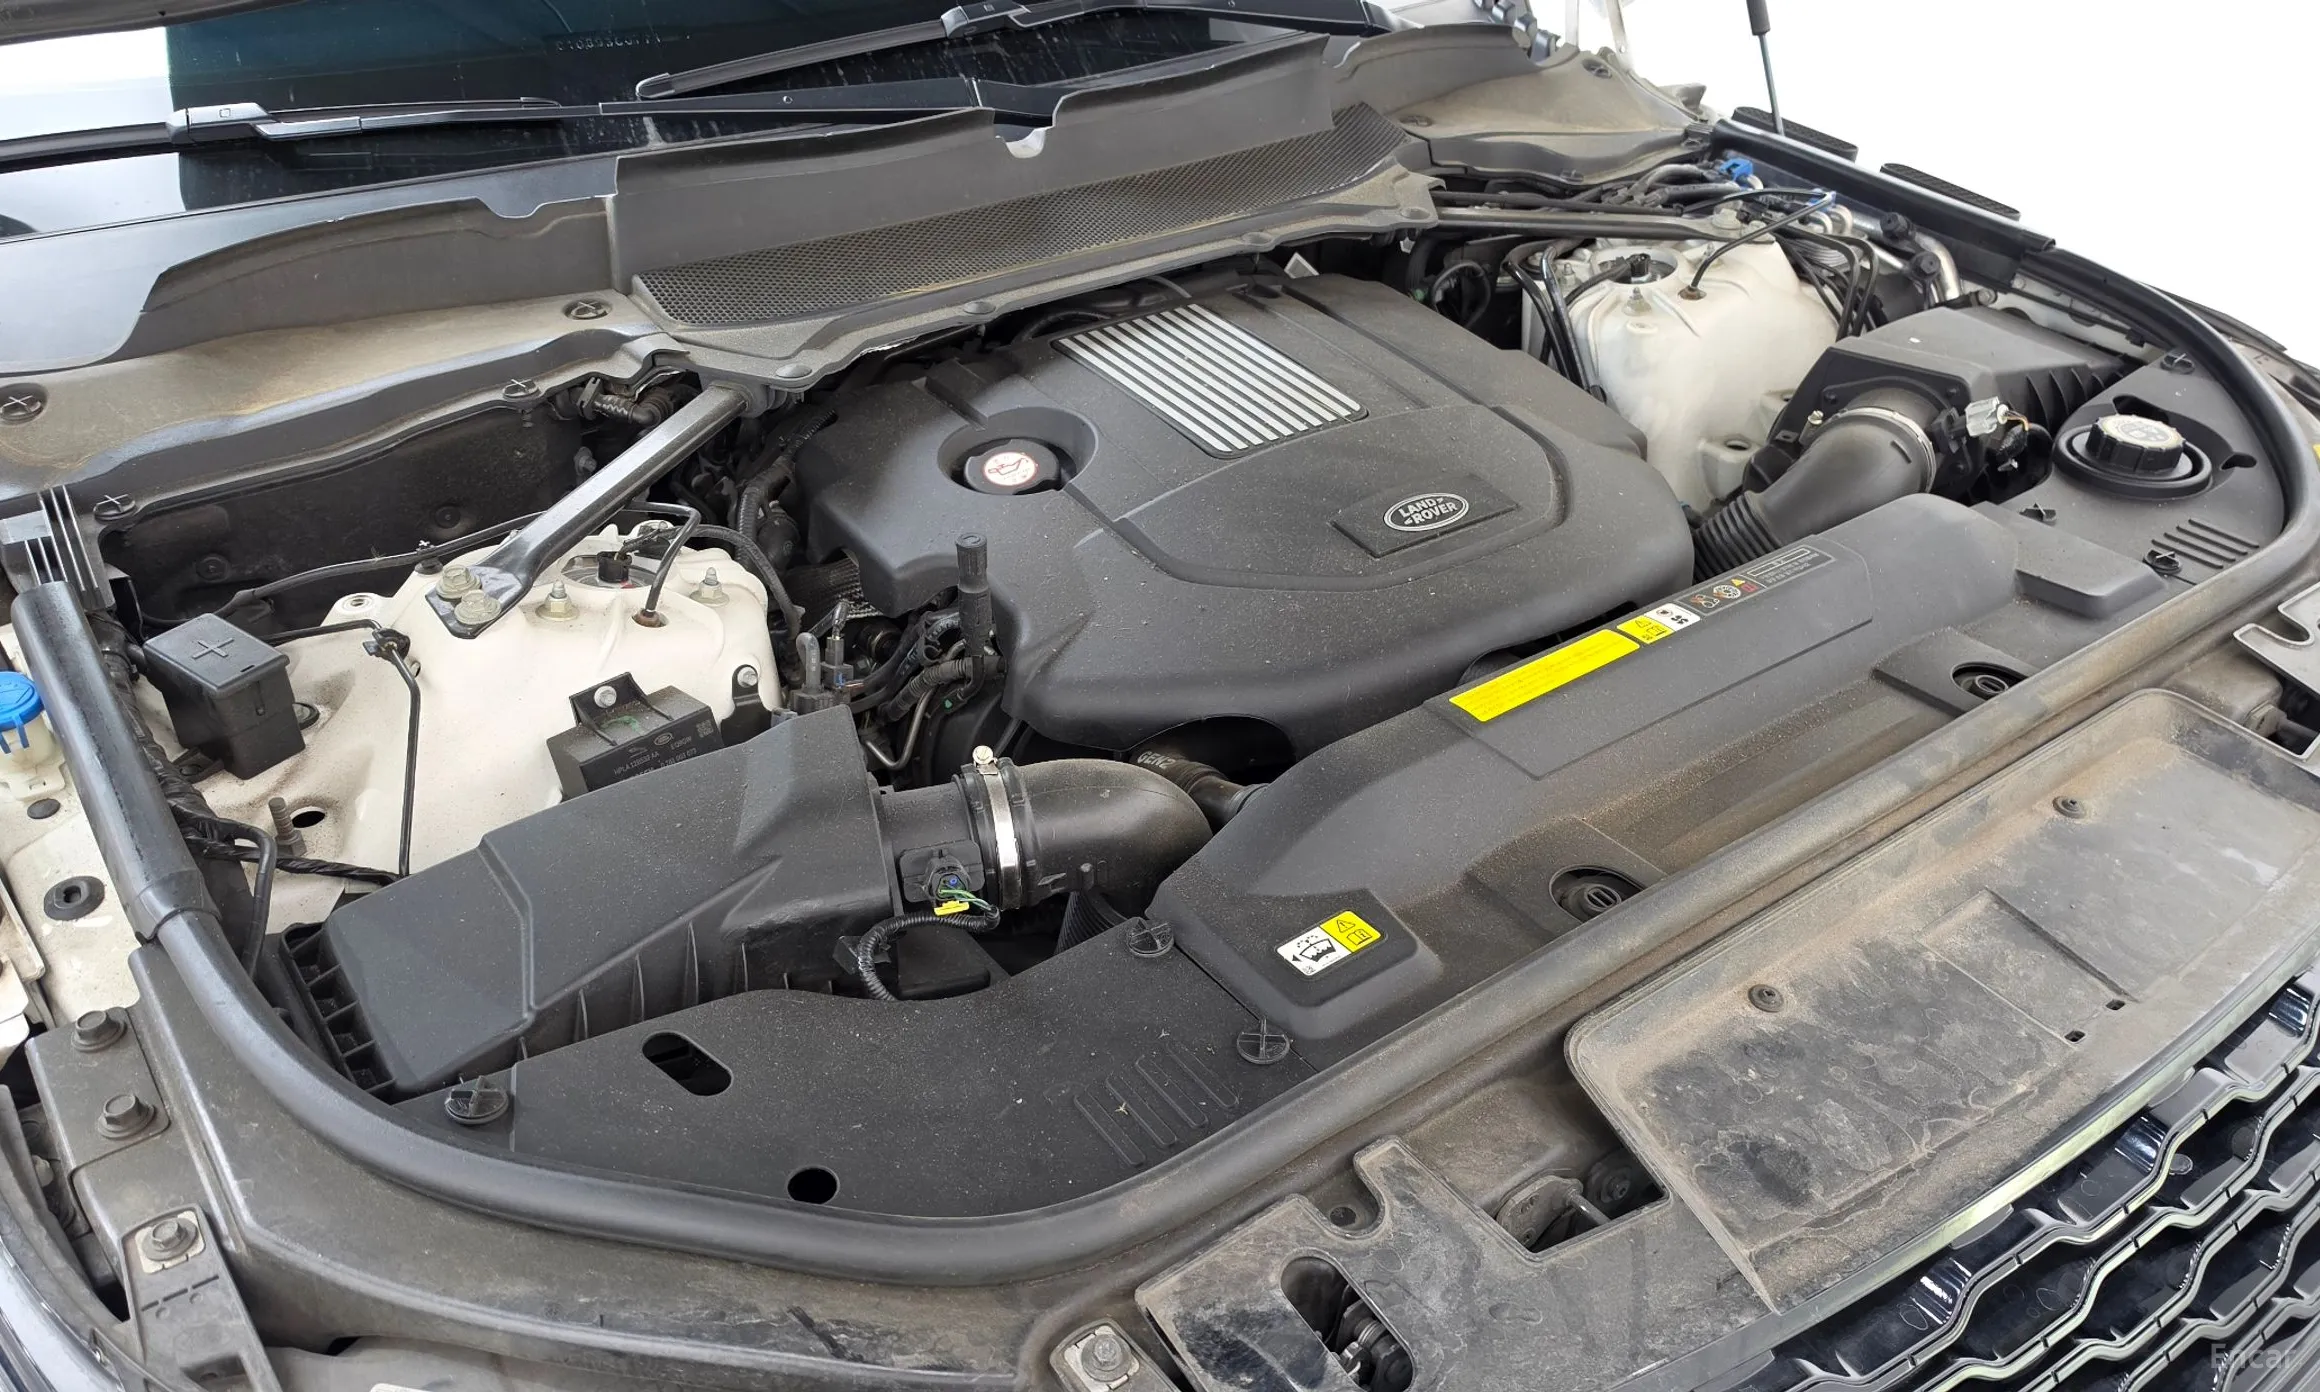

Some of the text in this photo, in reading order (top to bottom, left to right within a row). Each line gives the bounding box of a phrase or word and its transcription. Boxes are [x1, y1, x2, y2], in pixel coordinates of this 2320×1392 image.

[1398, 498, 1437, 517] LAND
[1411, 502, 1457, 524] ROVER
[1137, 750, 1176, 769] GEN2
